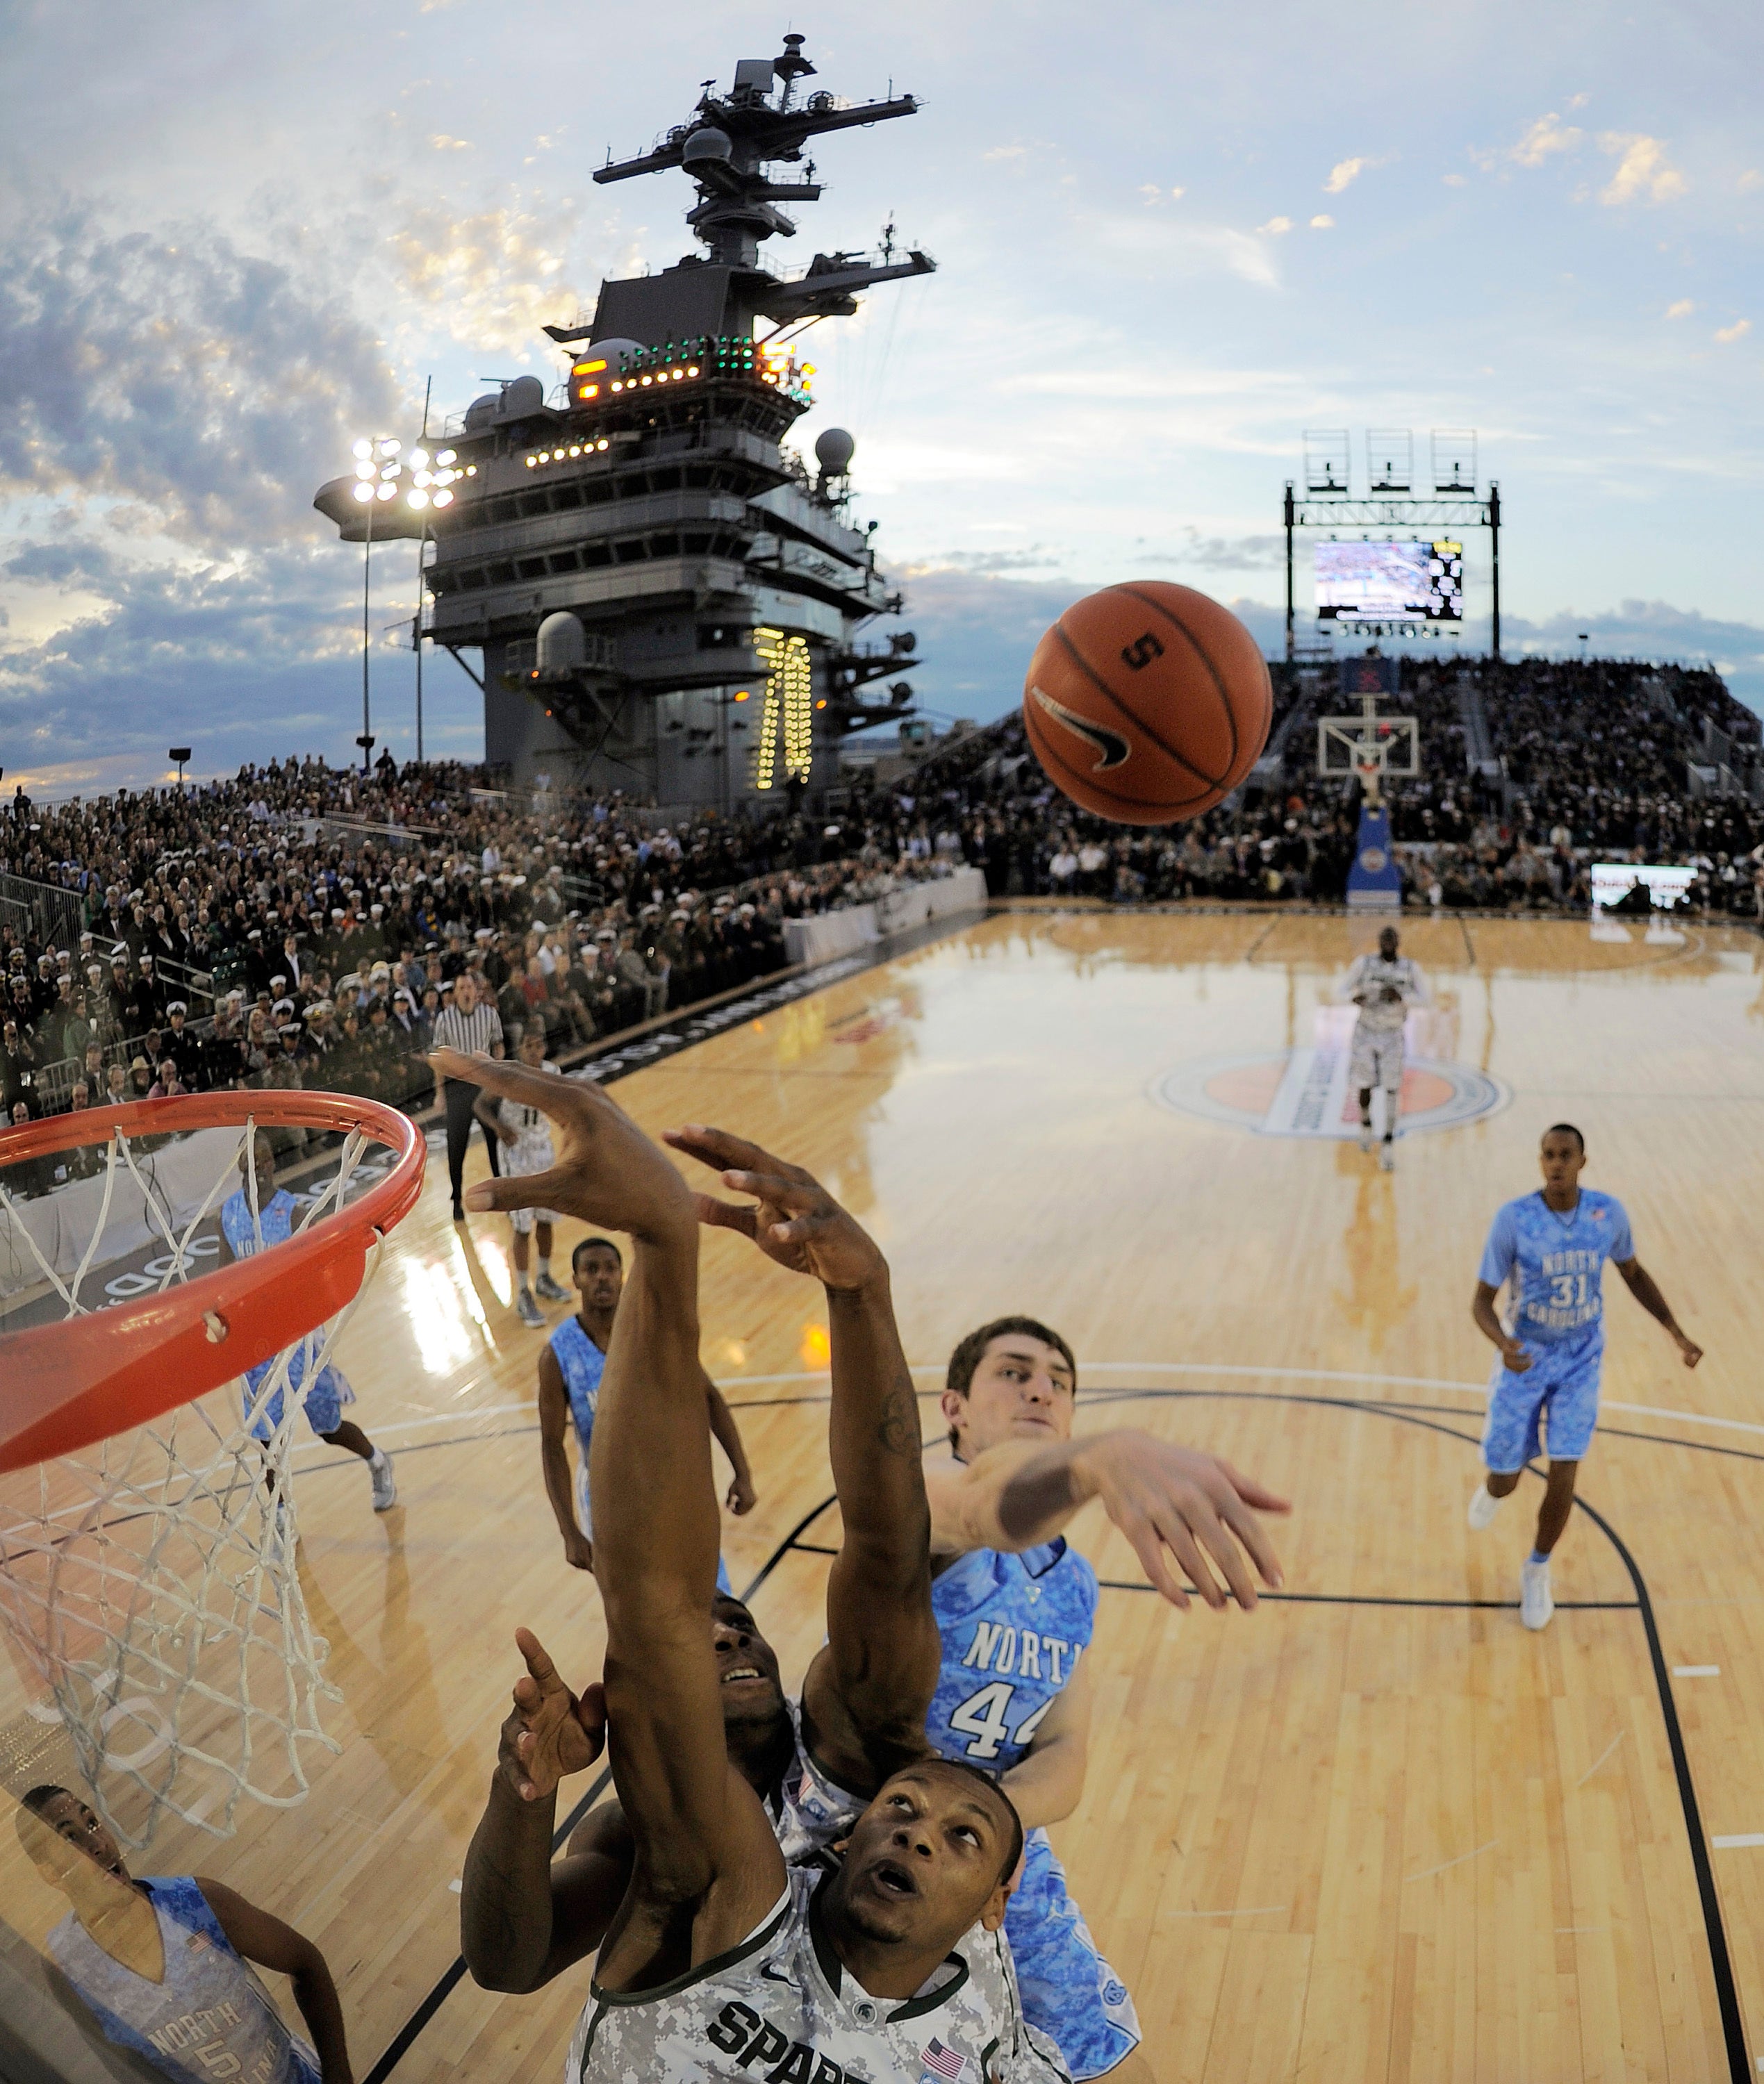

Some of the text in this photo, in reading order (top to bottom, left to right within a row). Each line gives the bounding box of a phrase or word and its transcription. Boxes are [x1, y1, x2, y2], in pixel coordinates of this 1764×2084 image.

[1549, 1273, 1587, 1307] 31
[147, 2001, 242, 2057] NORTH
[707, 2001, 870, 2084] SPAR
[194, 2040, 242, 2078] 5
